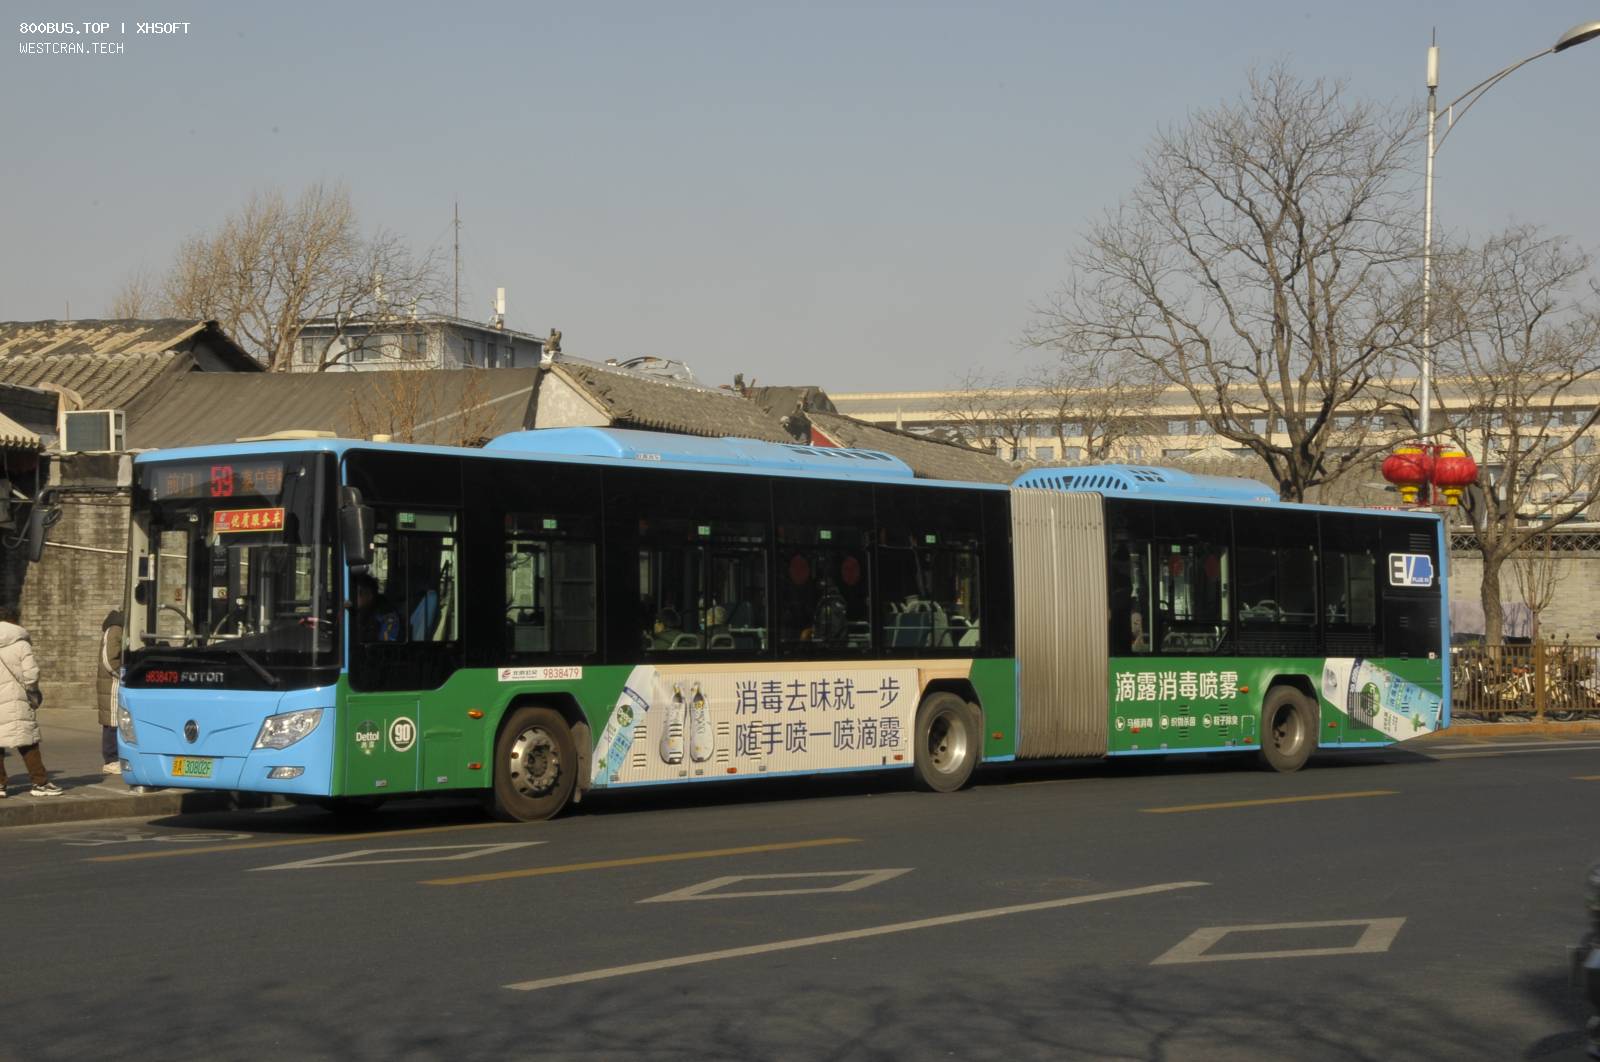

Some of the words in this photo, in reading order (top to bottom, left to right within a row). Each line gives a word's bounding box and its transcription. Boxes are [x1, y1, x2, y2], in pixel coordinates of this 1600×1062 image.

[145, 670, 178, 684] 9838479
[181, 671, 224, 683] FOTON
[543, 667, 579, 679] 9838479
[735, 676, 901, 715] 消毒去味就一步
[1115, 671, 1239, 702] 滴露消毒喷雾
[356, 731, 379, 742] Dettol
[394, 724, 411, 742] 90
[735, 716, 901, 757] 随手喷一喷滴露
